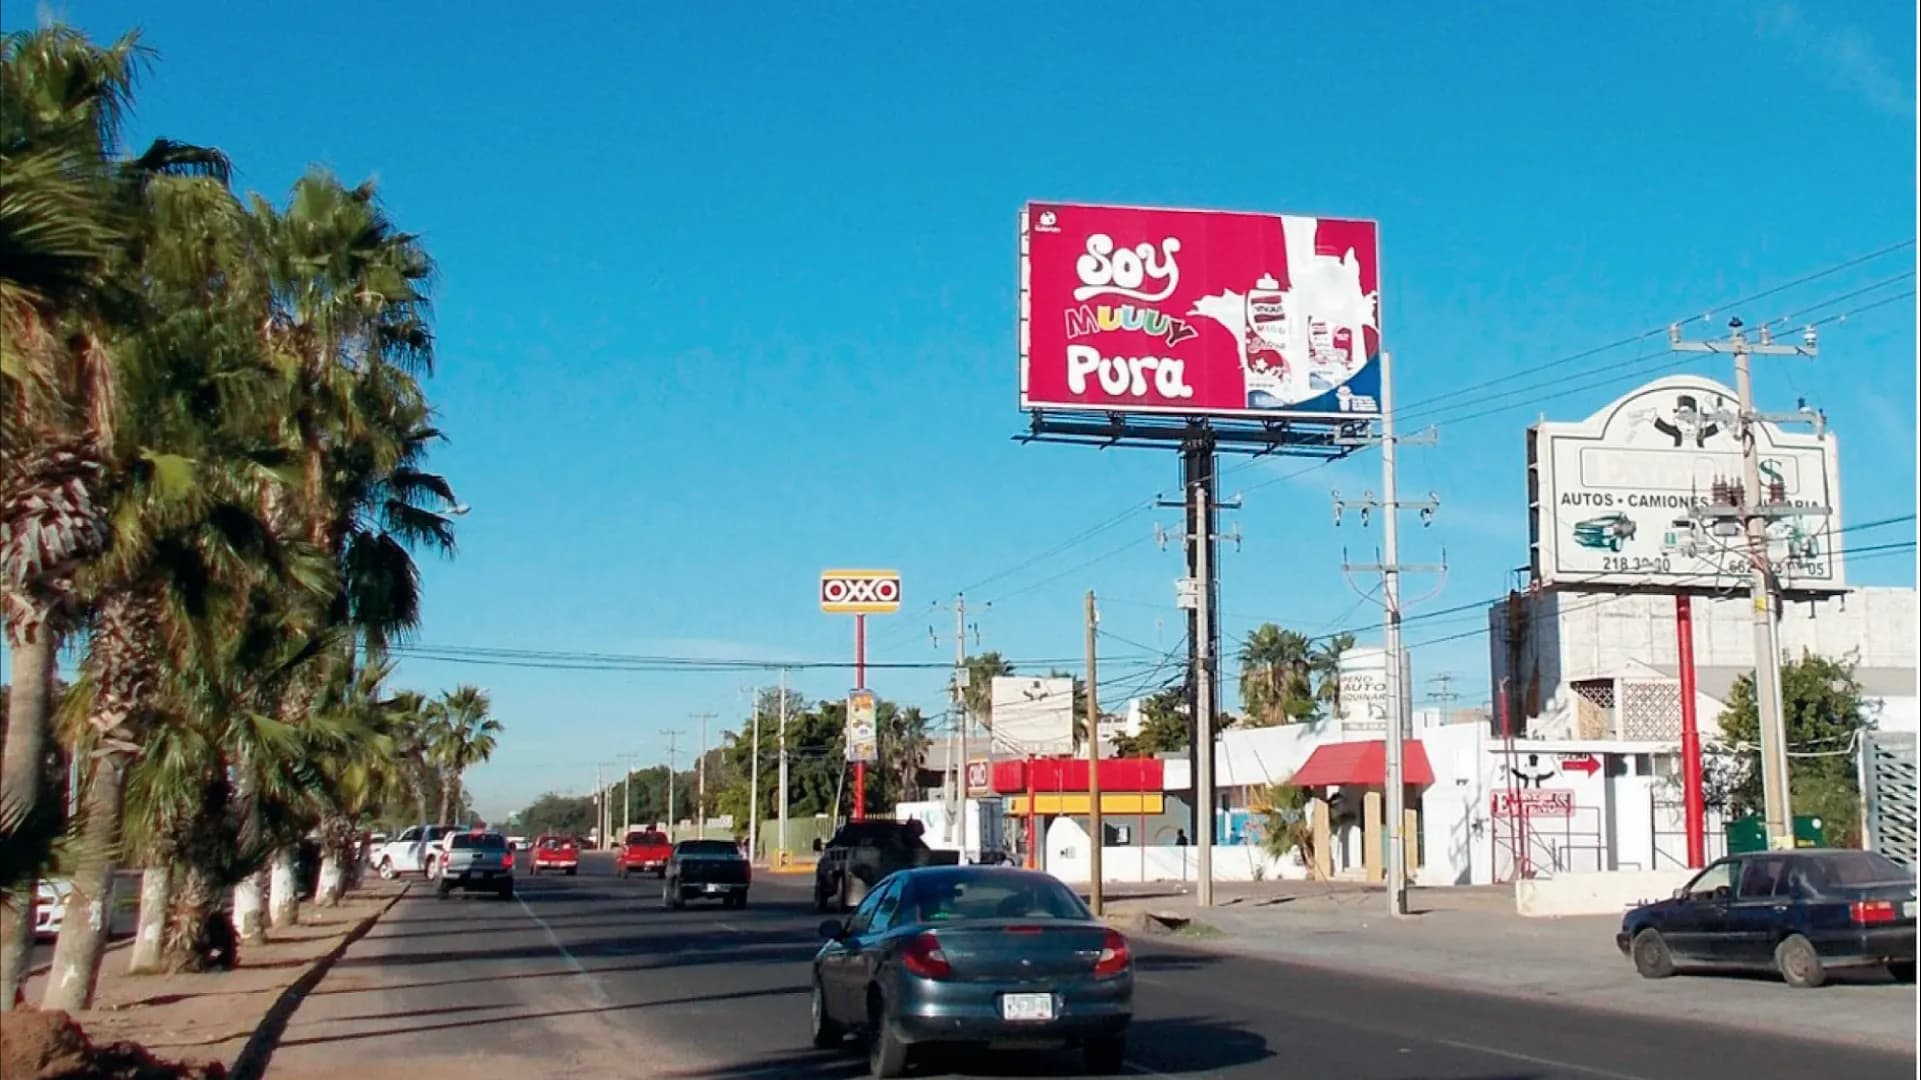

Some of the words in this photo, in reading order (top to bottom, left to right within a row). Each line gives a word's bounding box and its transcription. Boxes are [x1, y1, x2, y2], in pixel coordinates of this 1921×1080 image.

[1073, 233, 1181, 302] Soy
[1064, 304, 1198, 348] MUUUY
[1067, 345, 1193, 398] Pura
[1561, 492, 1614, 507] AUTOS
[1627, 494, 1709, 508] CAMIONES
[1603, 556, 1628, 571] 218
[824, 578, 898, 602] OXXO
